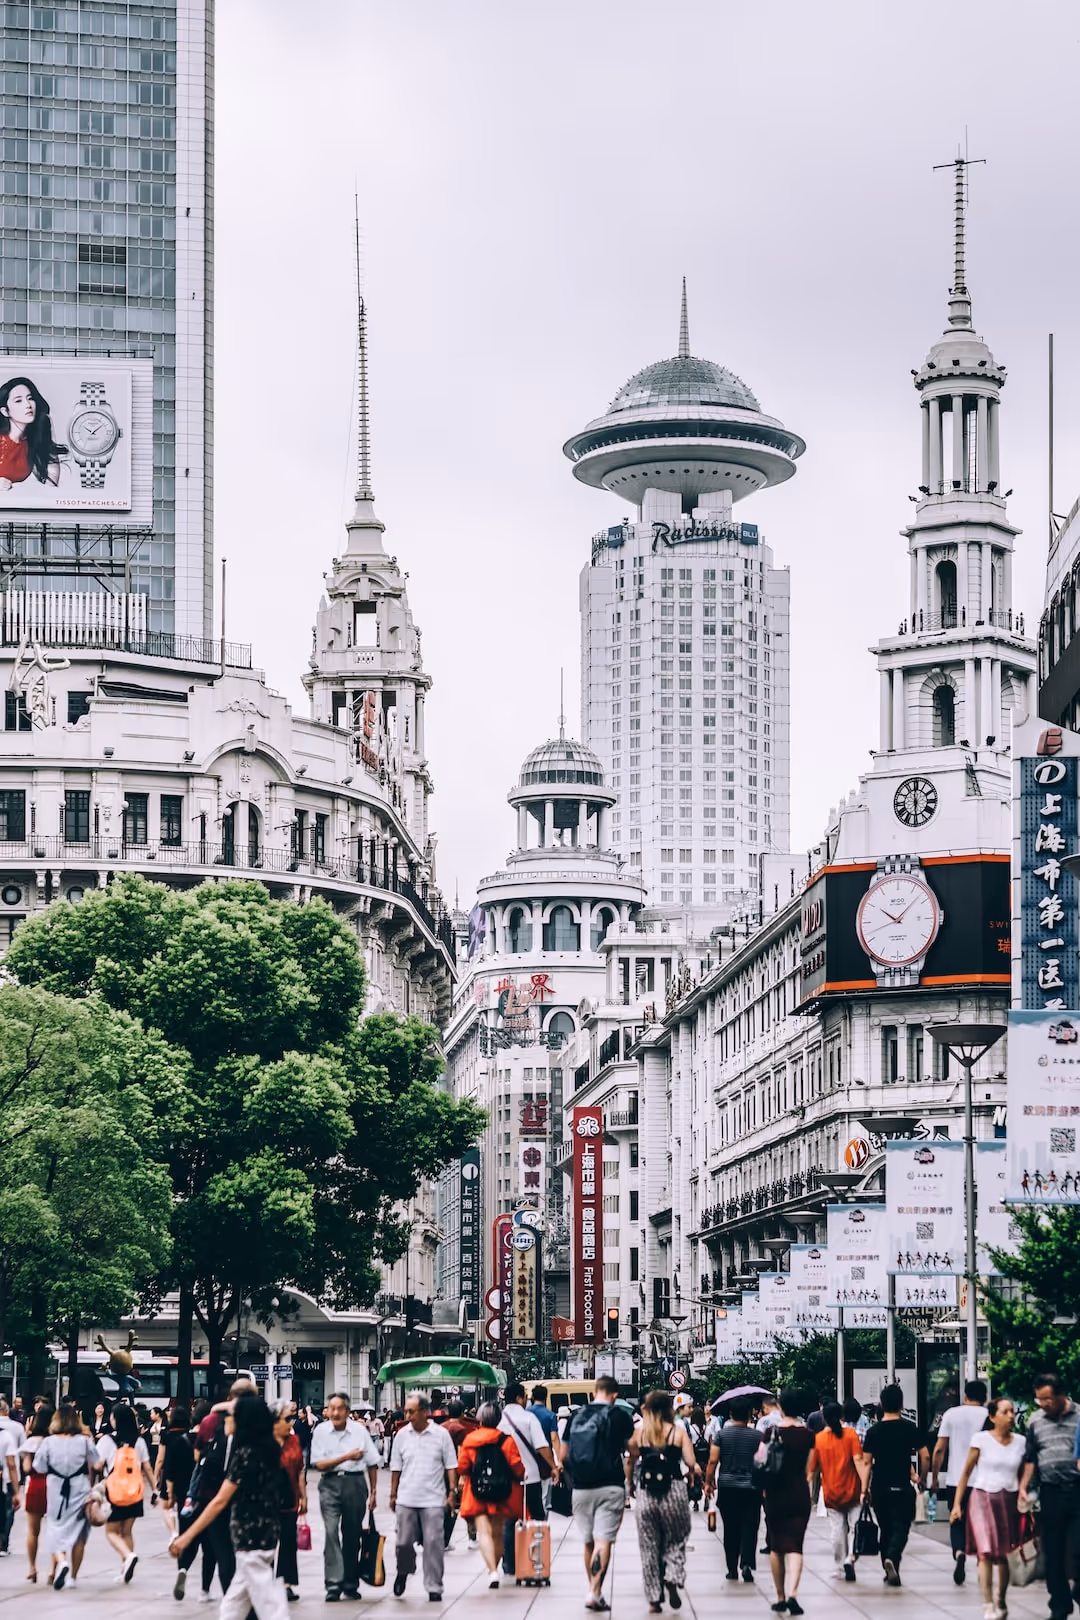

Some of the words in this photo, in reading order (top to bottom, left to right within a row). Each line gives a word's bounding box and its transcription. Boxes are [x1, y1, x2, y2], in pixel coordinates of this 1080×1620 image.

[651, 518, 739, 552] Radisson
[743, 530, 757, 538] BLU
[462, 1185, 473, 1305] 上海市第一百货商店
[584, 1266, 594, 1287] First
[584, 1289, 594, 1337] Foodhall
